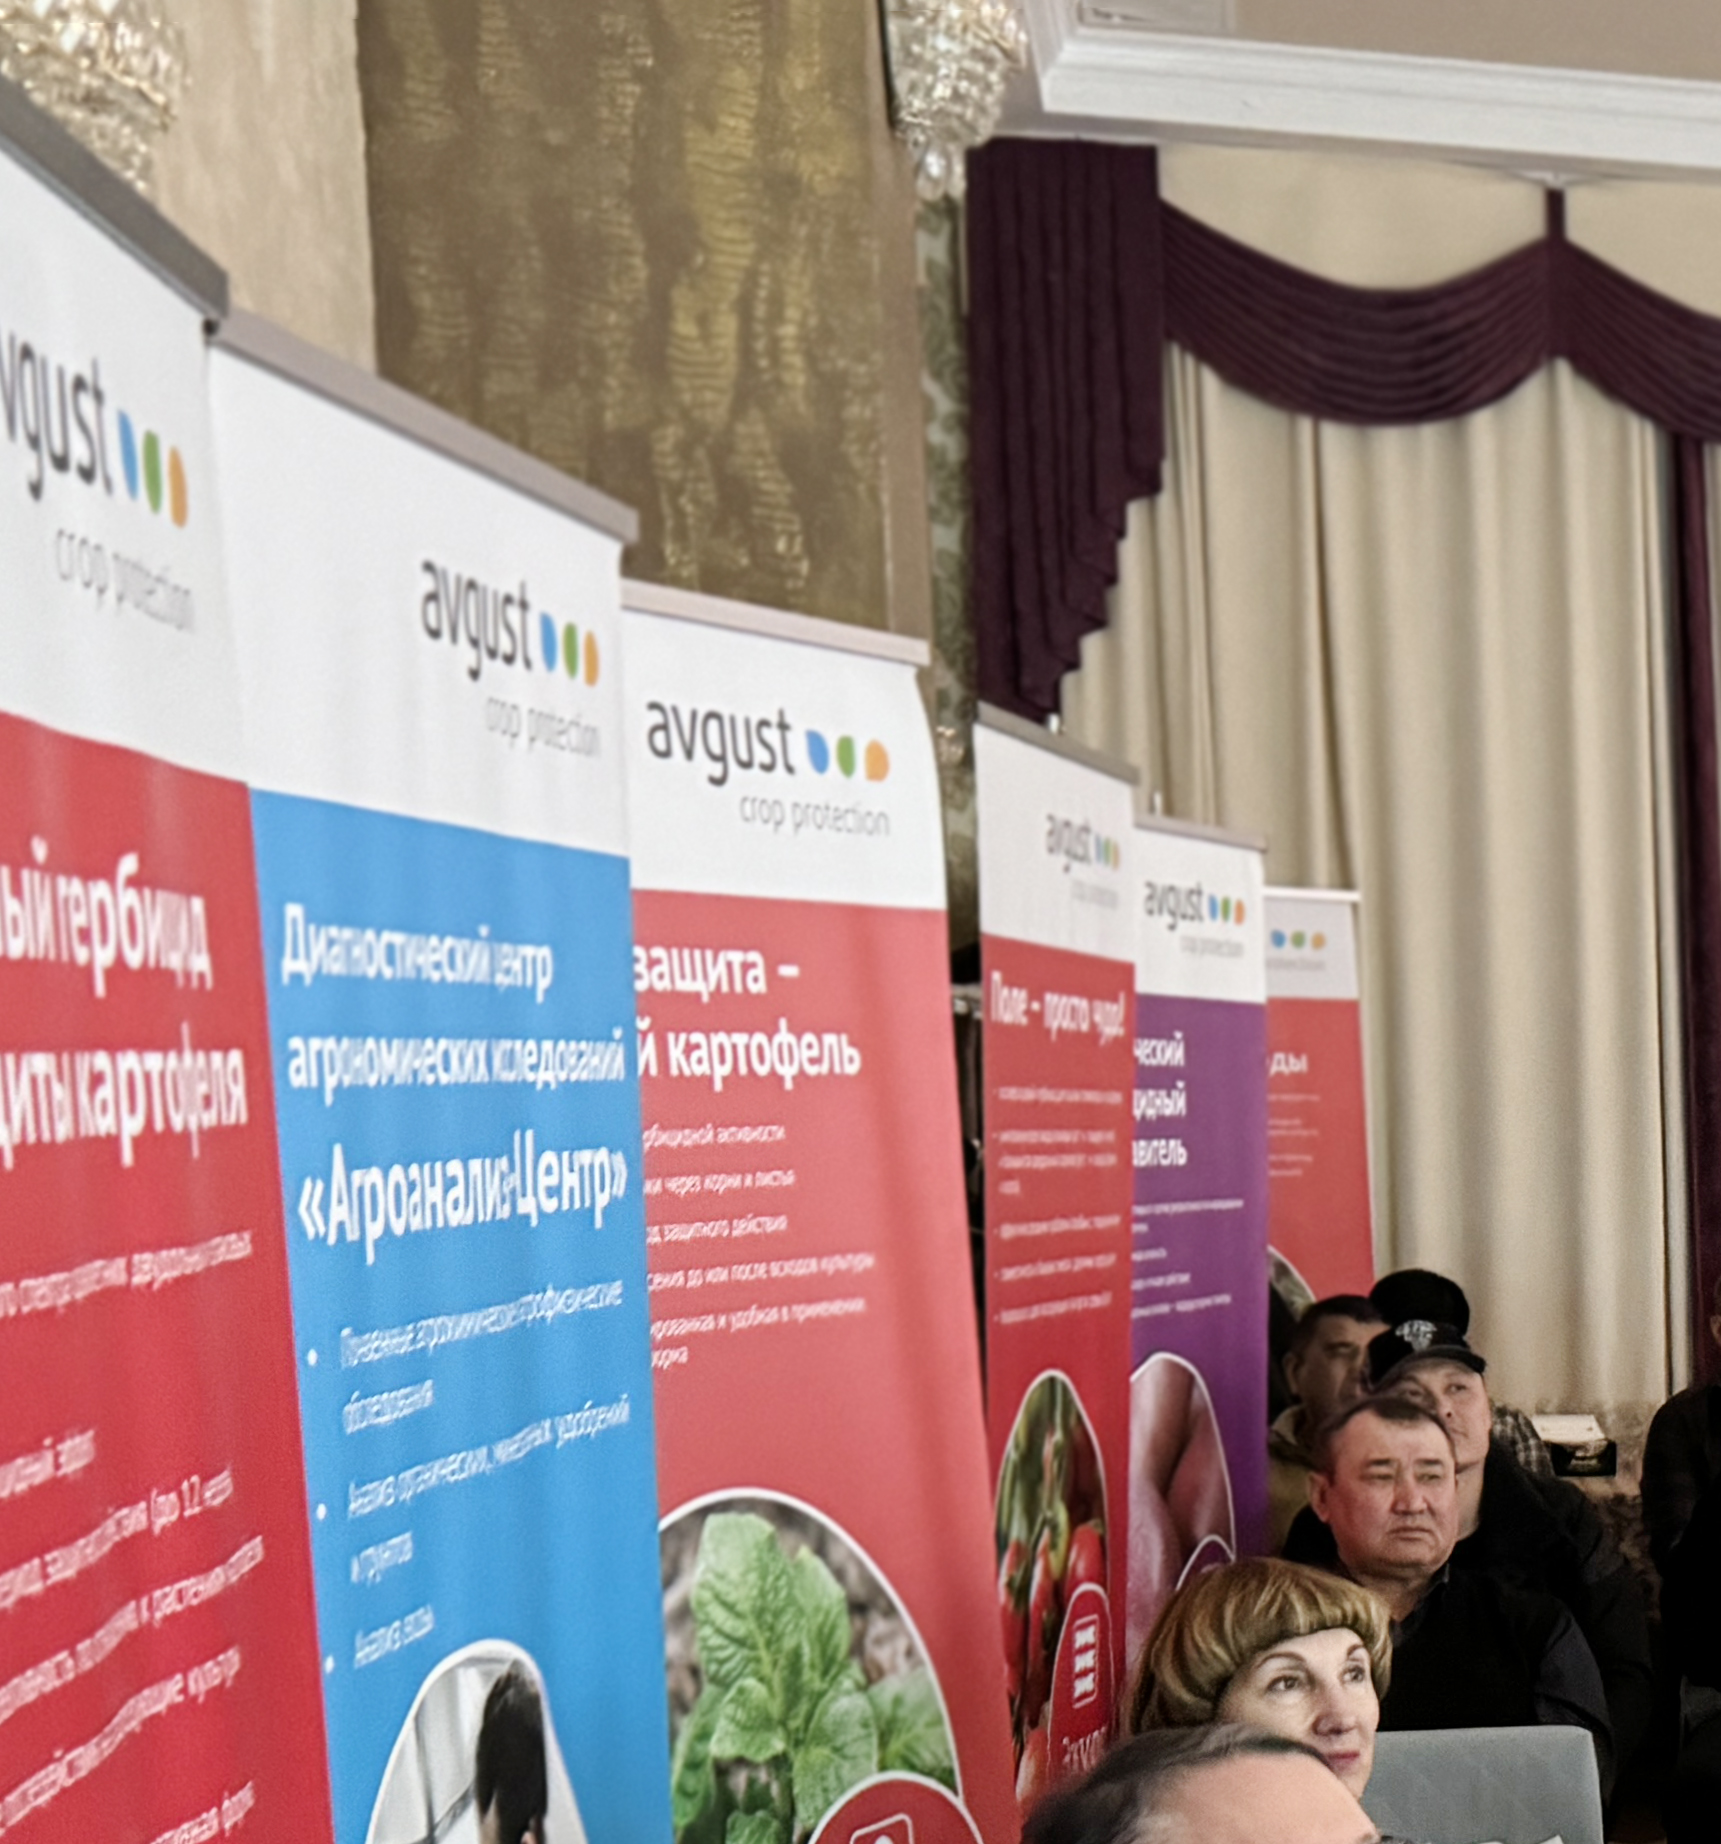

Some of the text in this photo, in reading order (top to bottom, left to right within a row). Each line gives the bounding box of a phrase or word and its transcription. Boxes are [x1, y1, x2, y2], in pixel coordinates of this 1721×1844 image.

[420, 559, 532, 681] avgust
[646, 700, 796, 787] avgust
[740, 795, 890, 837] crop protection
[1145, 881, 1204, 931] avgust
[633, 944, 768, 1004] защита
[667, 1016, 862, 1092] картофель
[0, 1050, 74, 1170] иты
